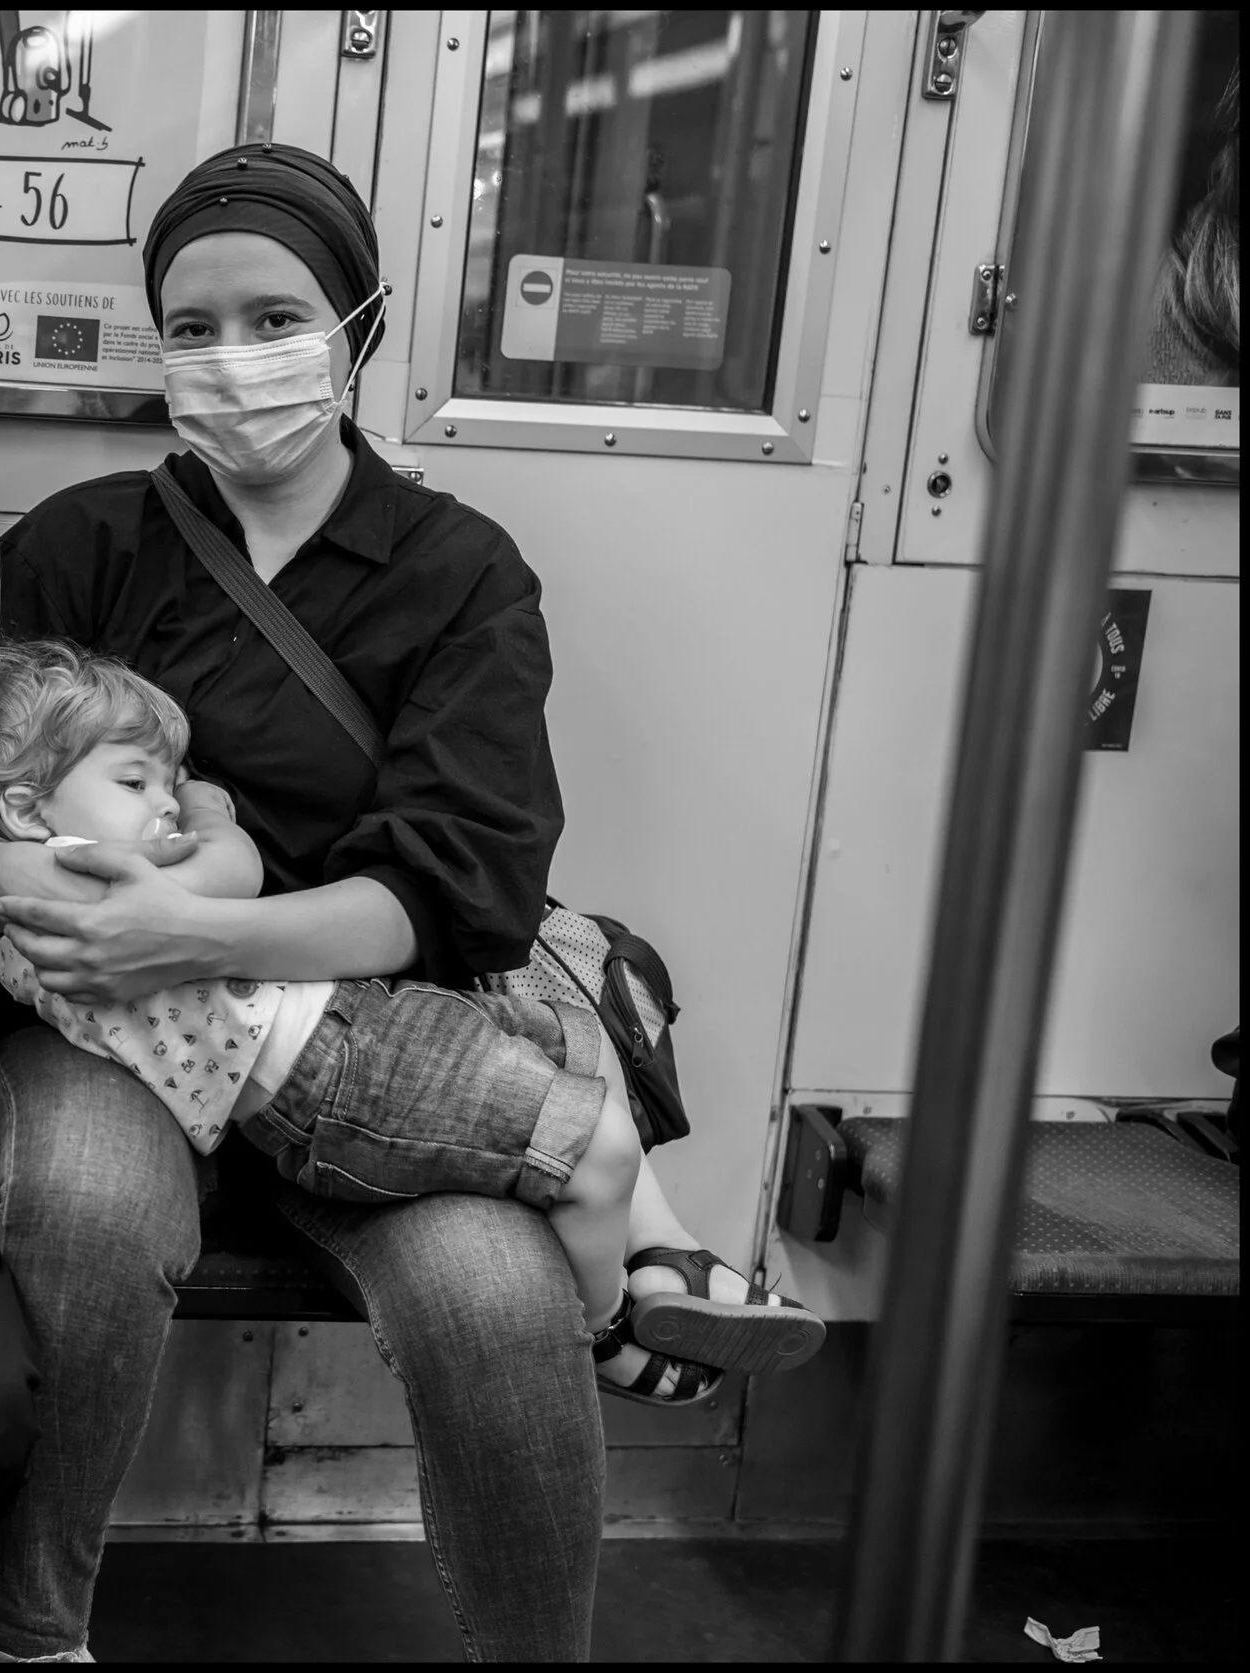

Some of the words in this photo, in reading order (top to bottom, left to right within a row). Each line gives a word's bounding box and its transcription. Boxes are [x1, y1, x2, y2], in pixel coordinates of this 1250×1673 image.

[21, 171, 69, 230] 56
[24, 291, 43, 305] LES
[45, 292, 99, 309] SOUTIENS
[102, 296, 116, 311] DE
[32, 361, 56, 369] UNION
[1105, 622, 1125, 655] TOUS
[1088, 688, 1116, 721] LIBRE
